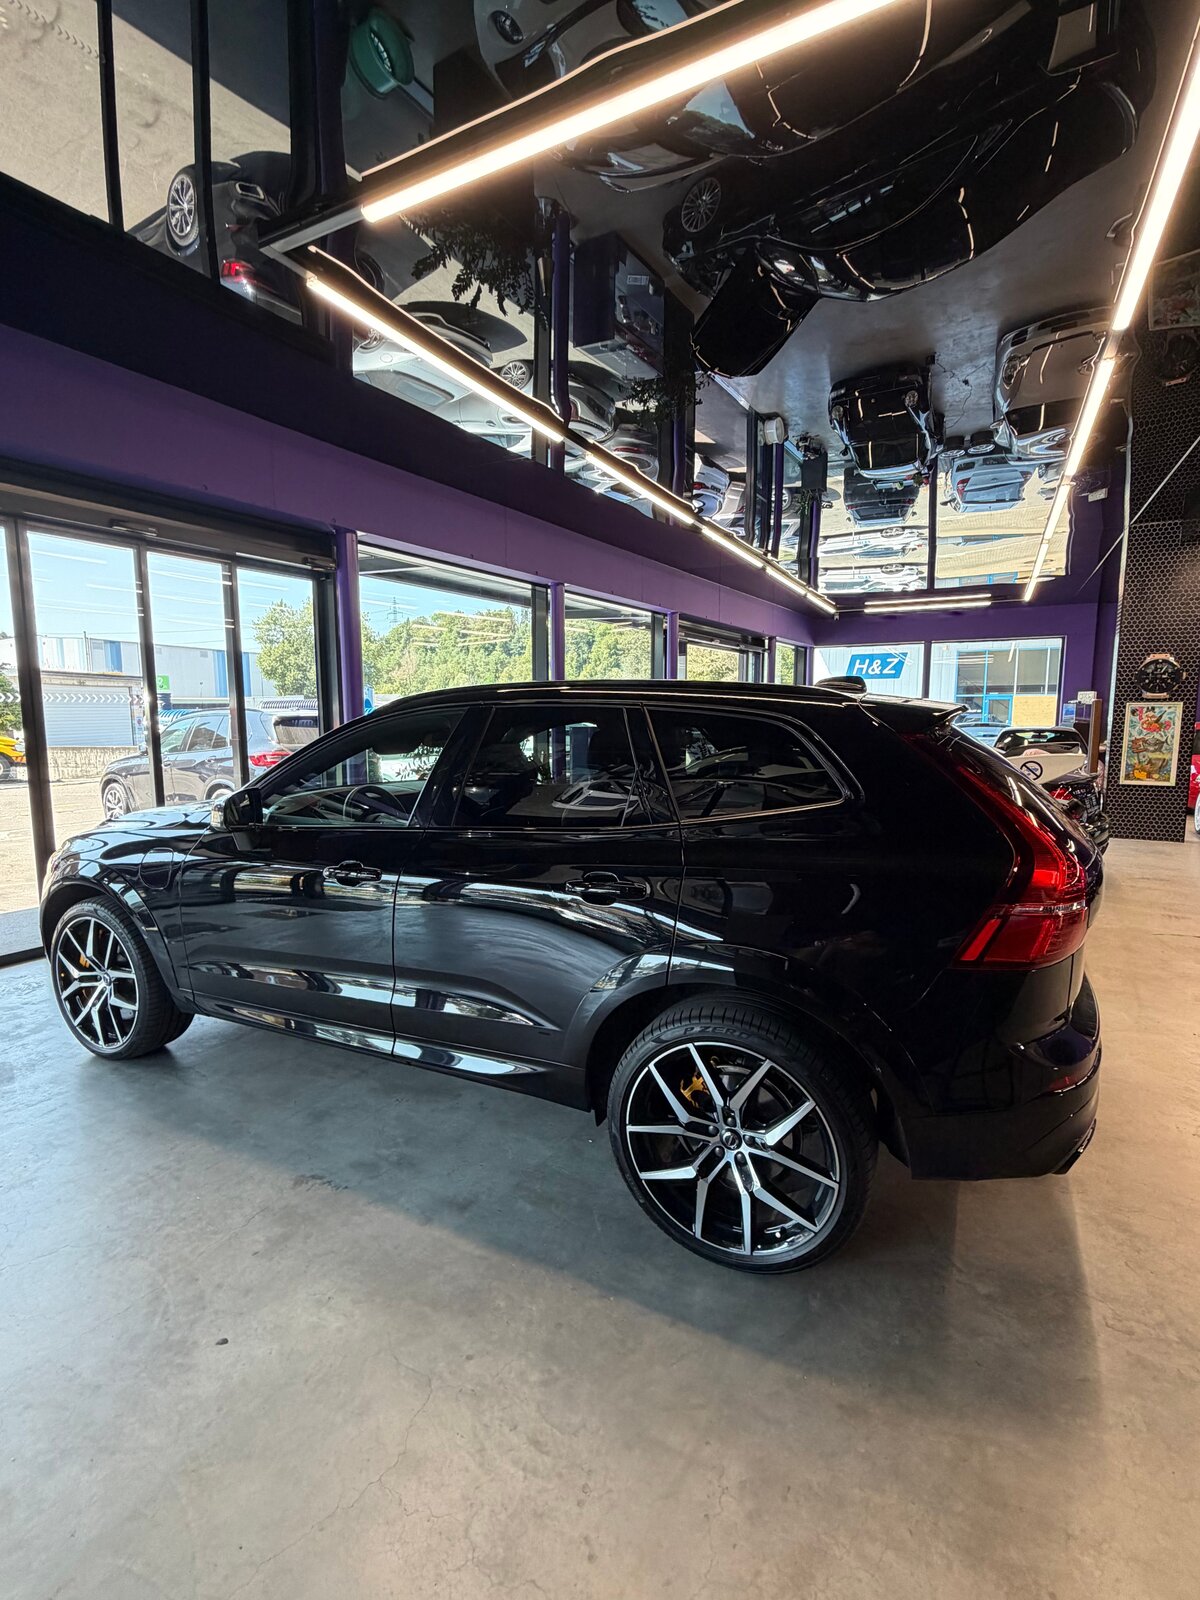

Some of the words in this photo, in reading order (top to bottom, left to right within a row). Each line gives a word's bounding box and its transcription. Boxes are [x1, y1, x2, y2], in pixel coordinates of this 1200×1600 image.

[853, 658, 900, 675] H&Z
[683, 1026, 695, 1036] P
[698, 1025, 752, 1039] ZERO
